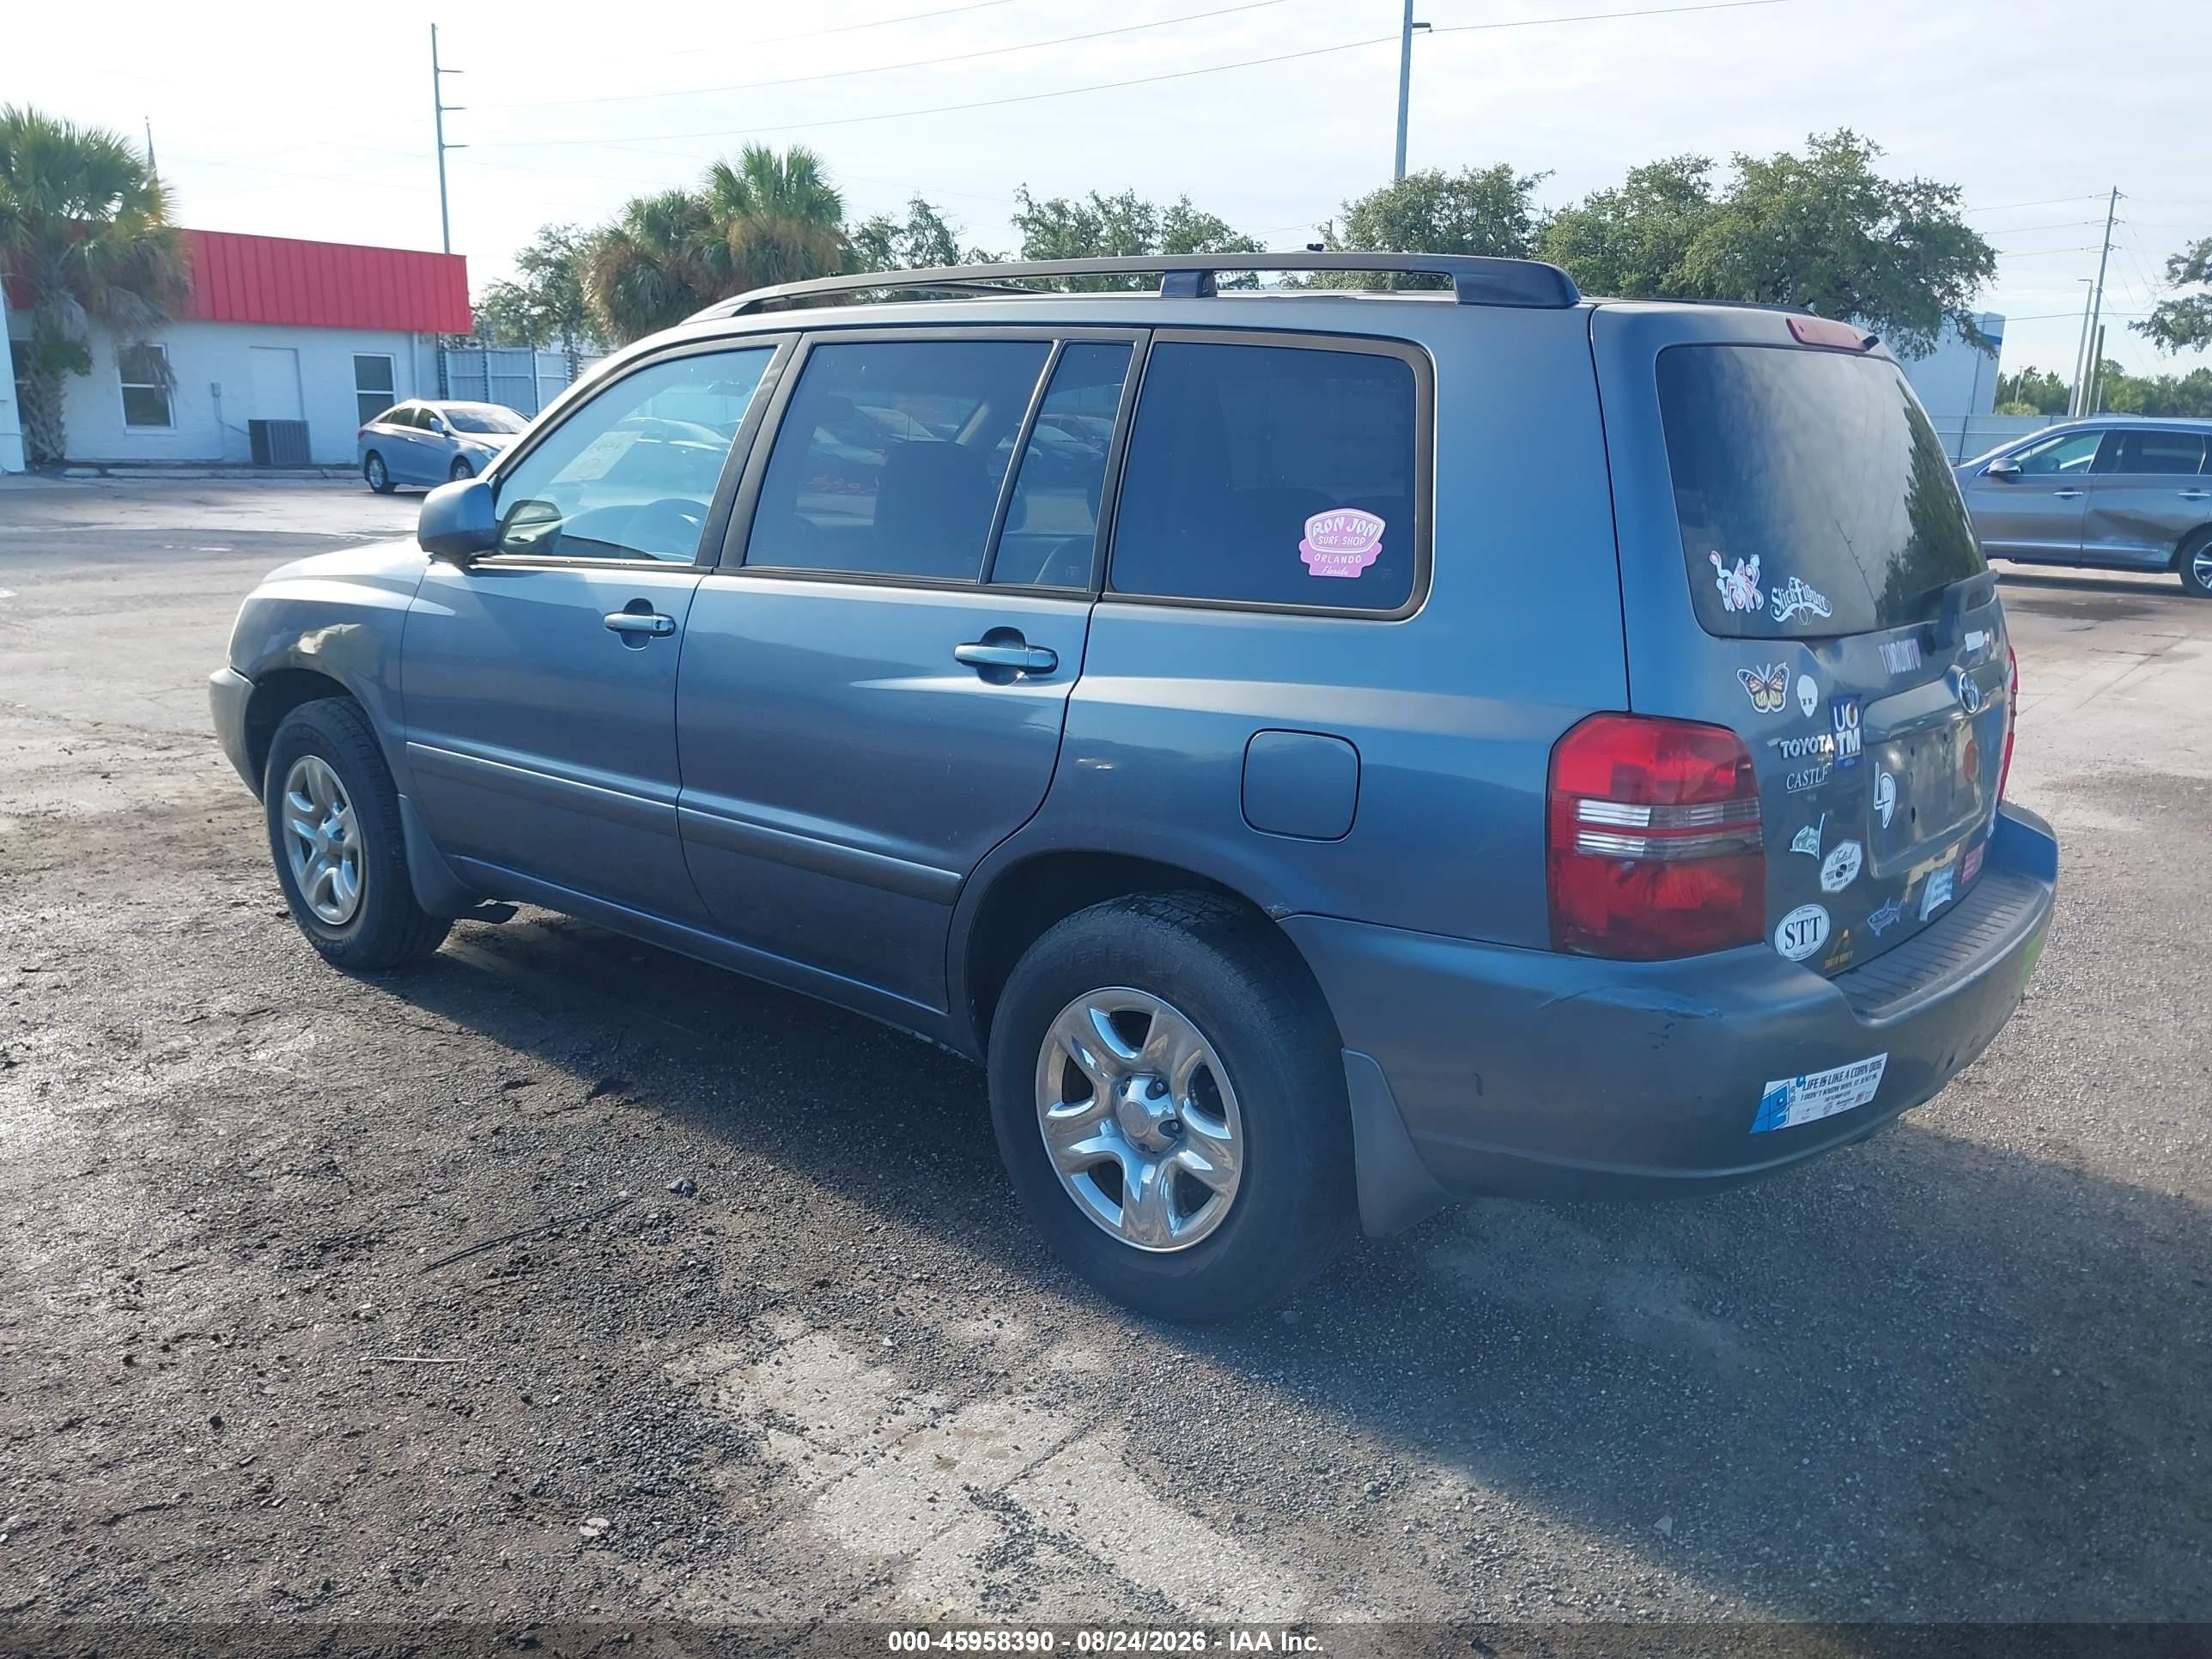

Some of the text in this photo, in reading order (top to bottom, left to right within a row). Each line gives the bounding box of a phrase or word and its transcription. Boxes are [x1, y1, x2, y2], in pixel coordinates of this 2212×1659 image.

[1313, 516, 1378, 538] RON JON
[1318, 536, 1365, 546] SURF SHOP
[1314, 553, 1362, 564] ORLANDO
[1779, 734, 1834, 758] TOYOTA
[1836, 728, 1861, 756] TM
[1784, 915, 1821, 951] STT
[1802, 1059, 1883, 1091] LIFE IS LIKE A CORN DOG
